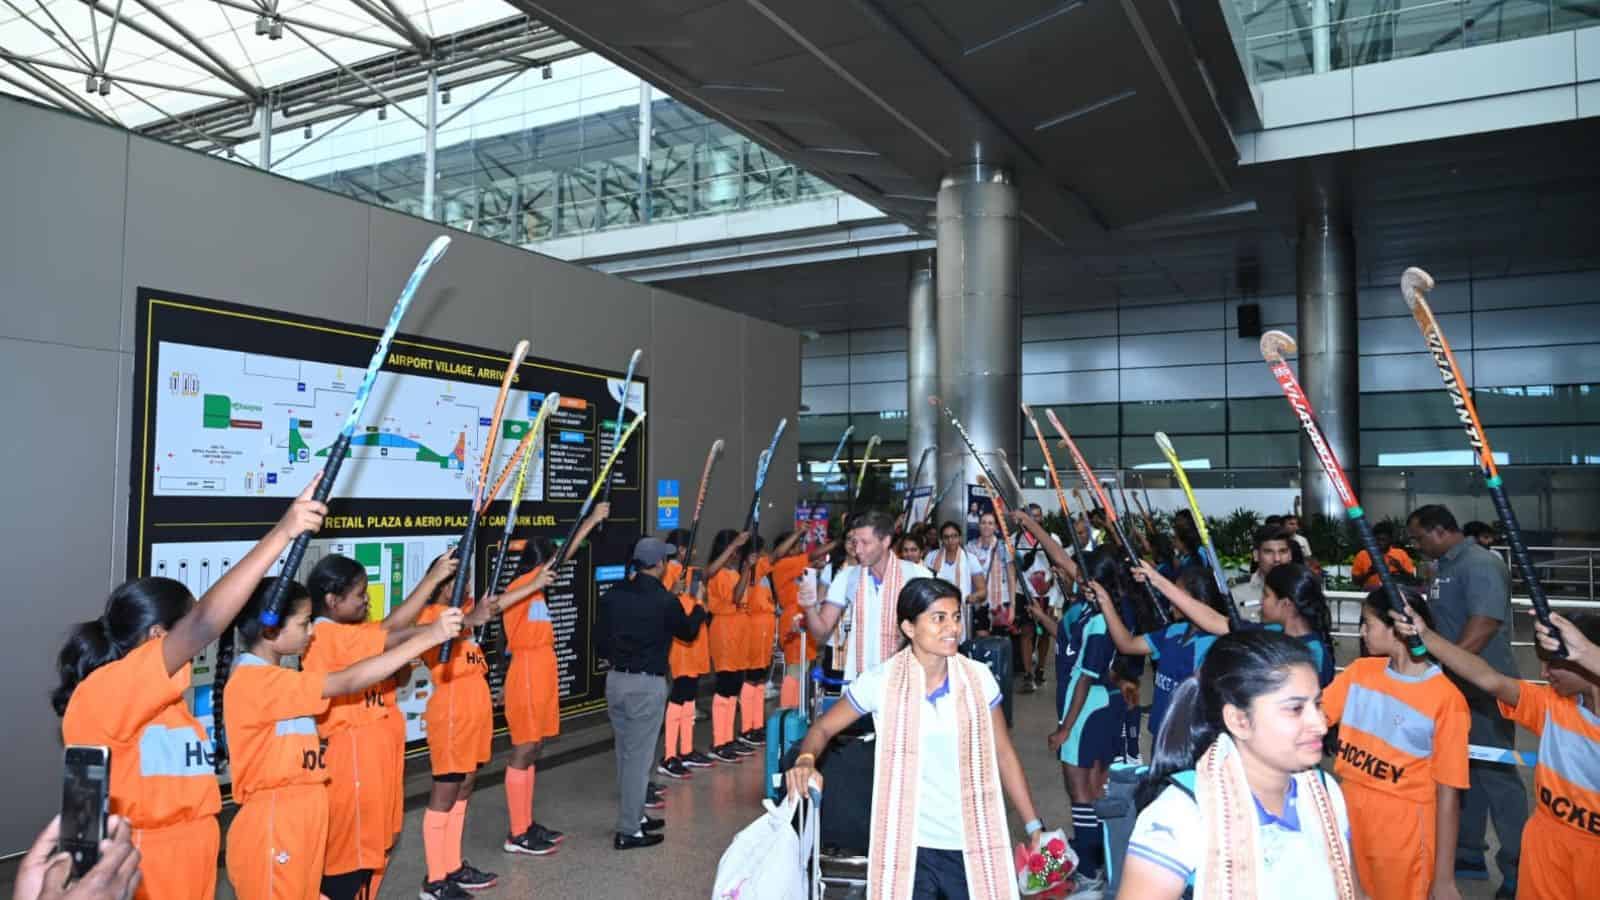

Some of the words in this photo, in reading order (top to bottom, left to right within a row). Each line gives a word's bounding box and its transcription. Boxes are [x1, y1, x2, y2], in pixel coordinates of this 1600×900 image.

[388, 352, 433, 370] AIRPORT
[435, 361, 476, 377] VILLAGE,
[477, 368, 520, 384] ARRIVS
[1428, 333, 1483, 448] VIJAYANTI
[325, 516, 365, 529] RETAIL
[367, 516, 401, 528] PLAZA
[404, 516, 412, 527] &
[414, 516, 442, 527] AERO
[444, 516, 469, 526] PLAZ
[515, 516, 531, 526] ARK
[533, 515, 557, 526] LEVEL
[1337, 738, 1405, 784] HOCKEY
[1540, 786, 1600, 837] OCKE
